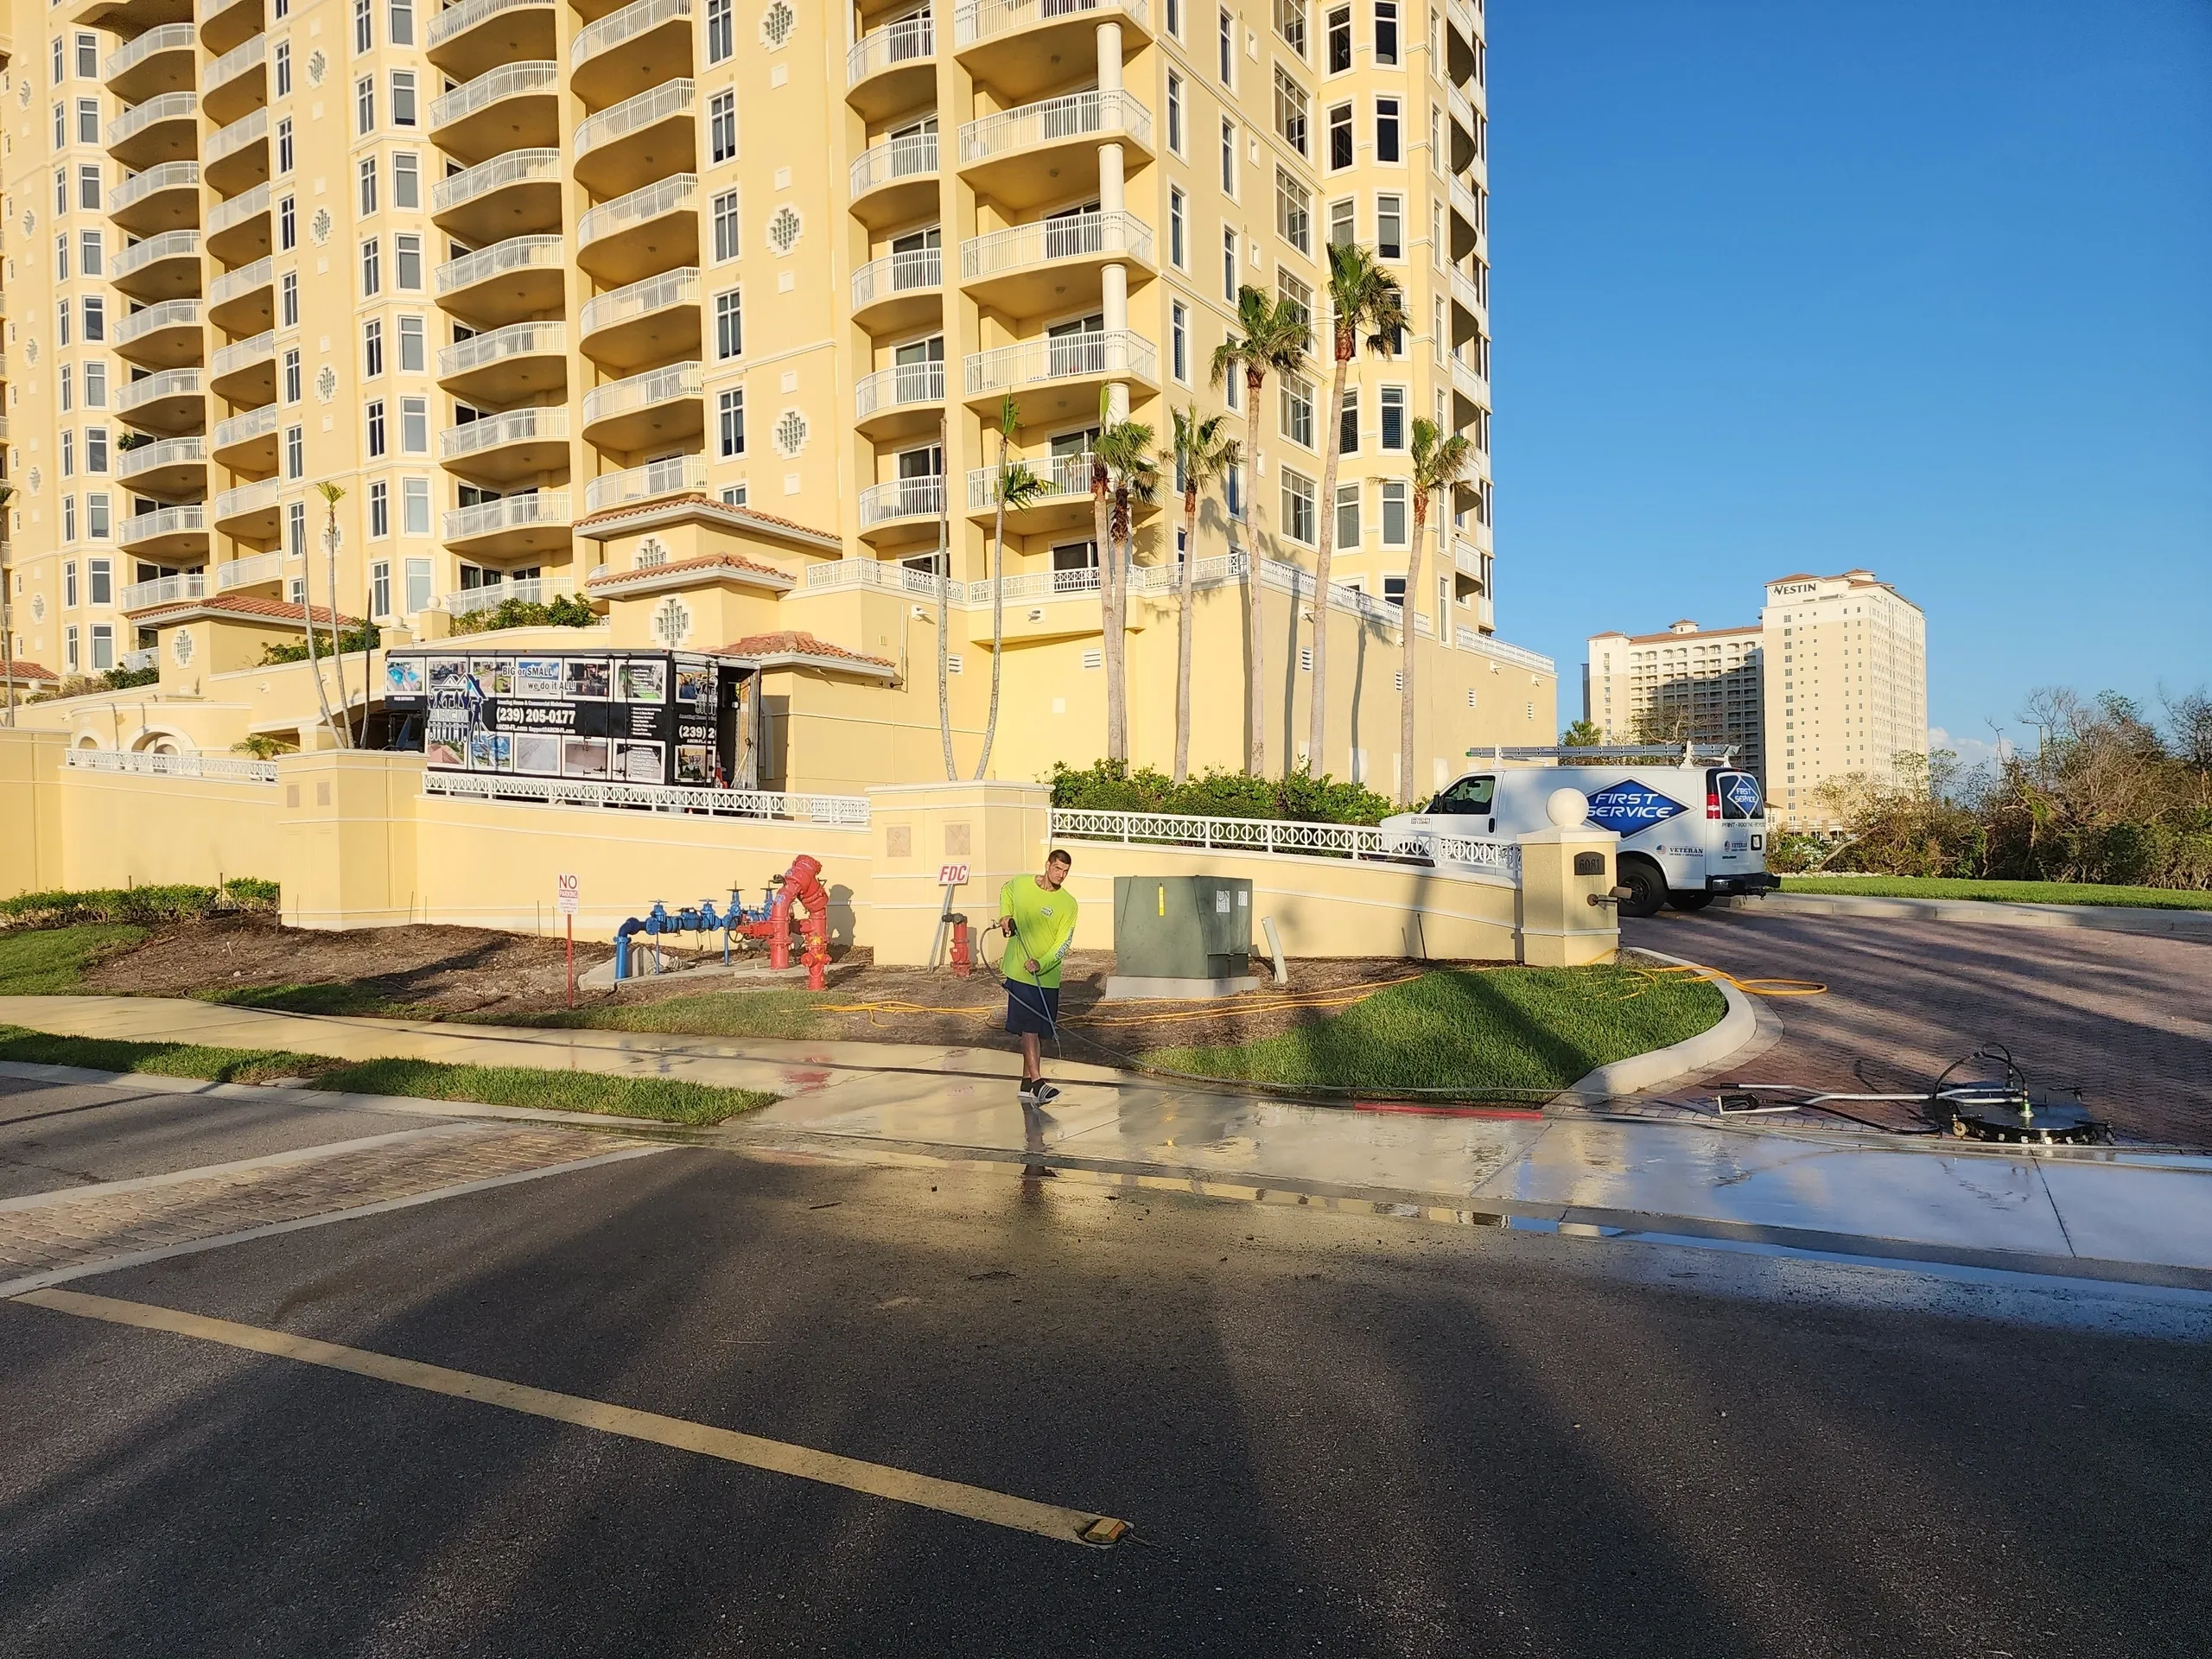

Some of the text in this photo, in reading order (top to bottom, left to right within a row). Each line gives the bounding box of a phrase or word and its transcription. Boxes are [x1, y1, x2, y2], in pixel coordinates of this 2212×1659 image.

[1768, 583, 1816, 596] WESTIN
[502, 666, 516, 676] BIG
[527, 667, 553, 677] SMALL
[551, 681, 557, 690] it
[559, 681, 577, 691] ALL!
[429, 709, 469, 722] AHCM
[496, 707, 576, 724] (239) 205-0177
[679, 725, 706, 740] (239)
[1595, 793, 1659, 804] FIRST
[1587, 805, 1674, 818] SERVICE
[1579, 858, 1600, 872] 6081
[939, 865, 967, 881] FDC
[559, 874, 577, 889] NO
